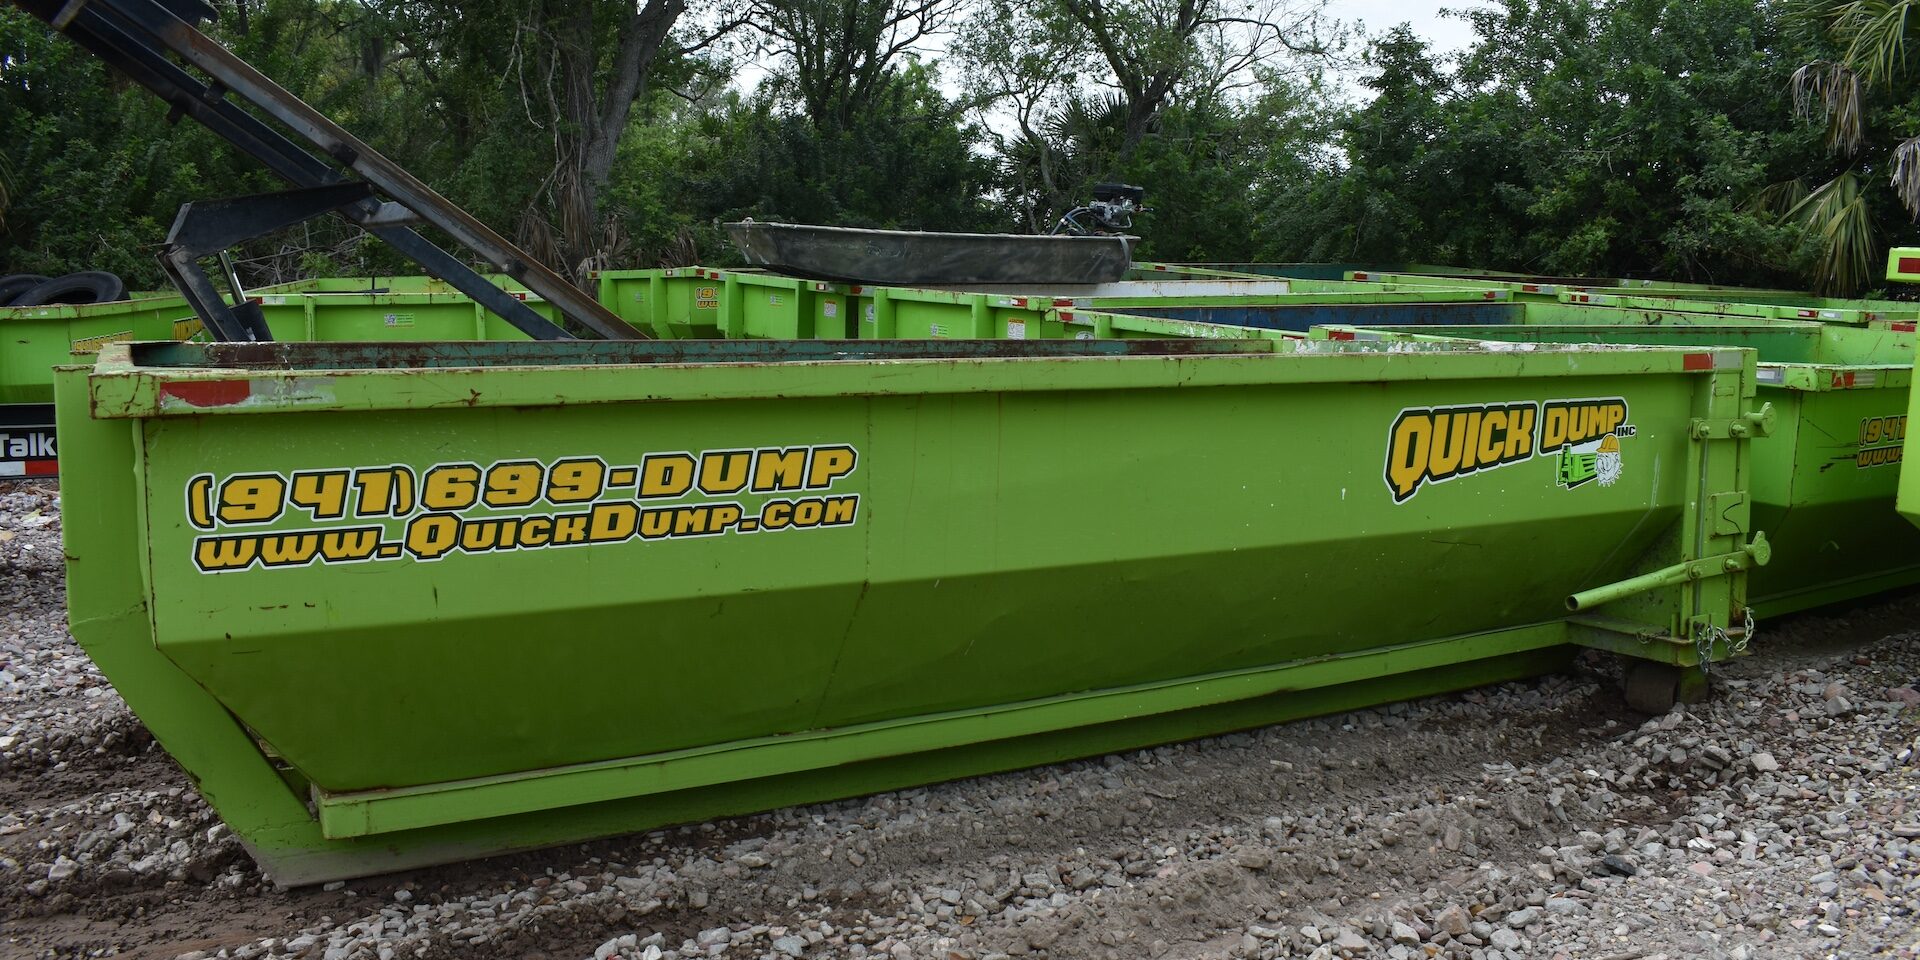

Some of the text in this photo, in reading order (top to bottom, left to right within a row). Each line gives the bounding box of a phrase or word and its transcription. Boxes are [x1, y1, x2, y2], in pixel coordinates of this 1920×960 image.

[1385, 398, 1636, 503] QUICK DUMP INC
